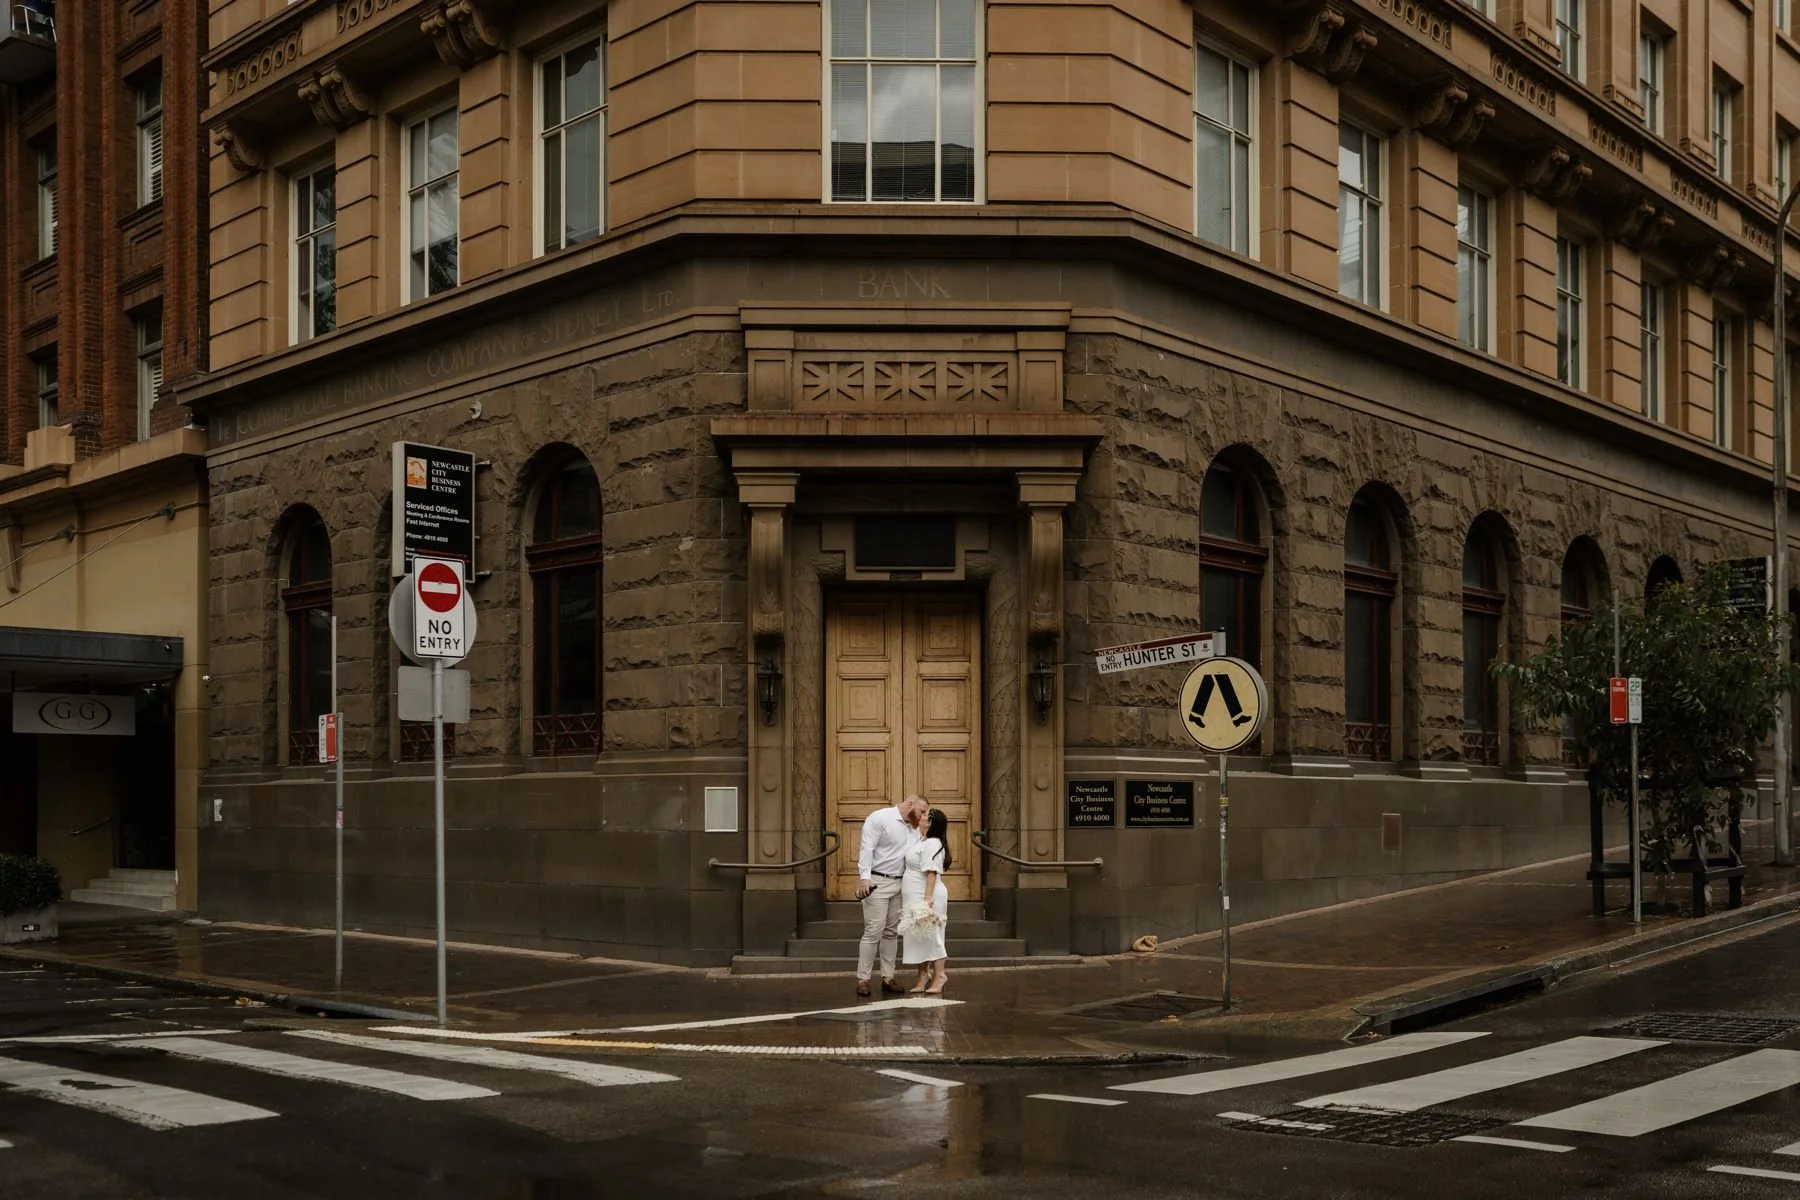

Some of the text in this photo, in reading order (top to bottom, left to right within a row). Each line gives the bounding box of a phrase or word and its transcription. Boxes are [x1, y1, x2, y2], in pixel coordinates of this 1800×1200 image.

[858, 266, 952, 299] BANK
[431, 460, 471, 473] NEWCASTLE
[431, 468, 447, 477] CITY
[431, 476, 461, 487] BUSINESS
[431, 485, 457, 494] CENTRE
[406, 501, 459, 515] Serviced Offices
[406, 511, 423, 519] Meeting
[428, 514, 454, 522] Conference
[419, 520, 440, 528] Internet
[406, 532, 424, 540] Phone:
[428, 619, 452, 635] NO
[420, 636, 461, 650] ENTRY
[1098, 645, 1144, 656] NEWCASTLE
[1123, 643, 1196, 667] HUNTER ST
[1106, 655, 1116, 663] NO
[1101, 661, 1122, 671] ENTRY
[1147, 784, 1173, 793] Newcastle
[1070, 795, 1084, 804] City
[1133, 795, 1187, 806] City Business Centre
